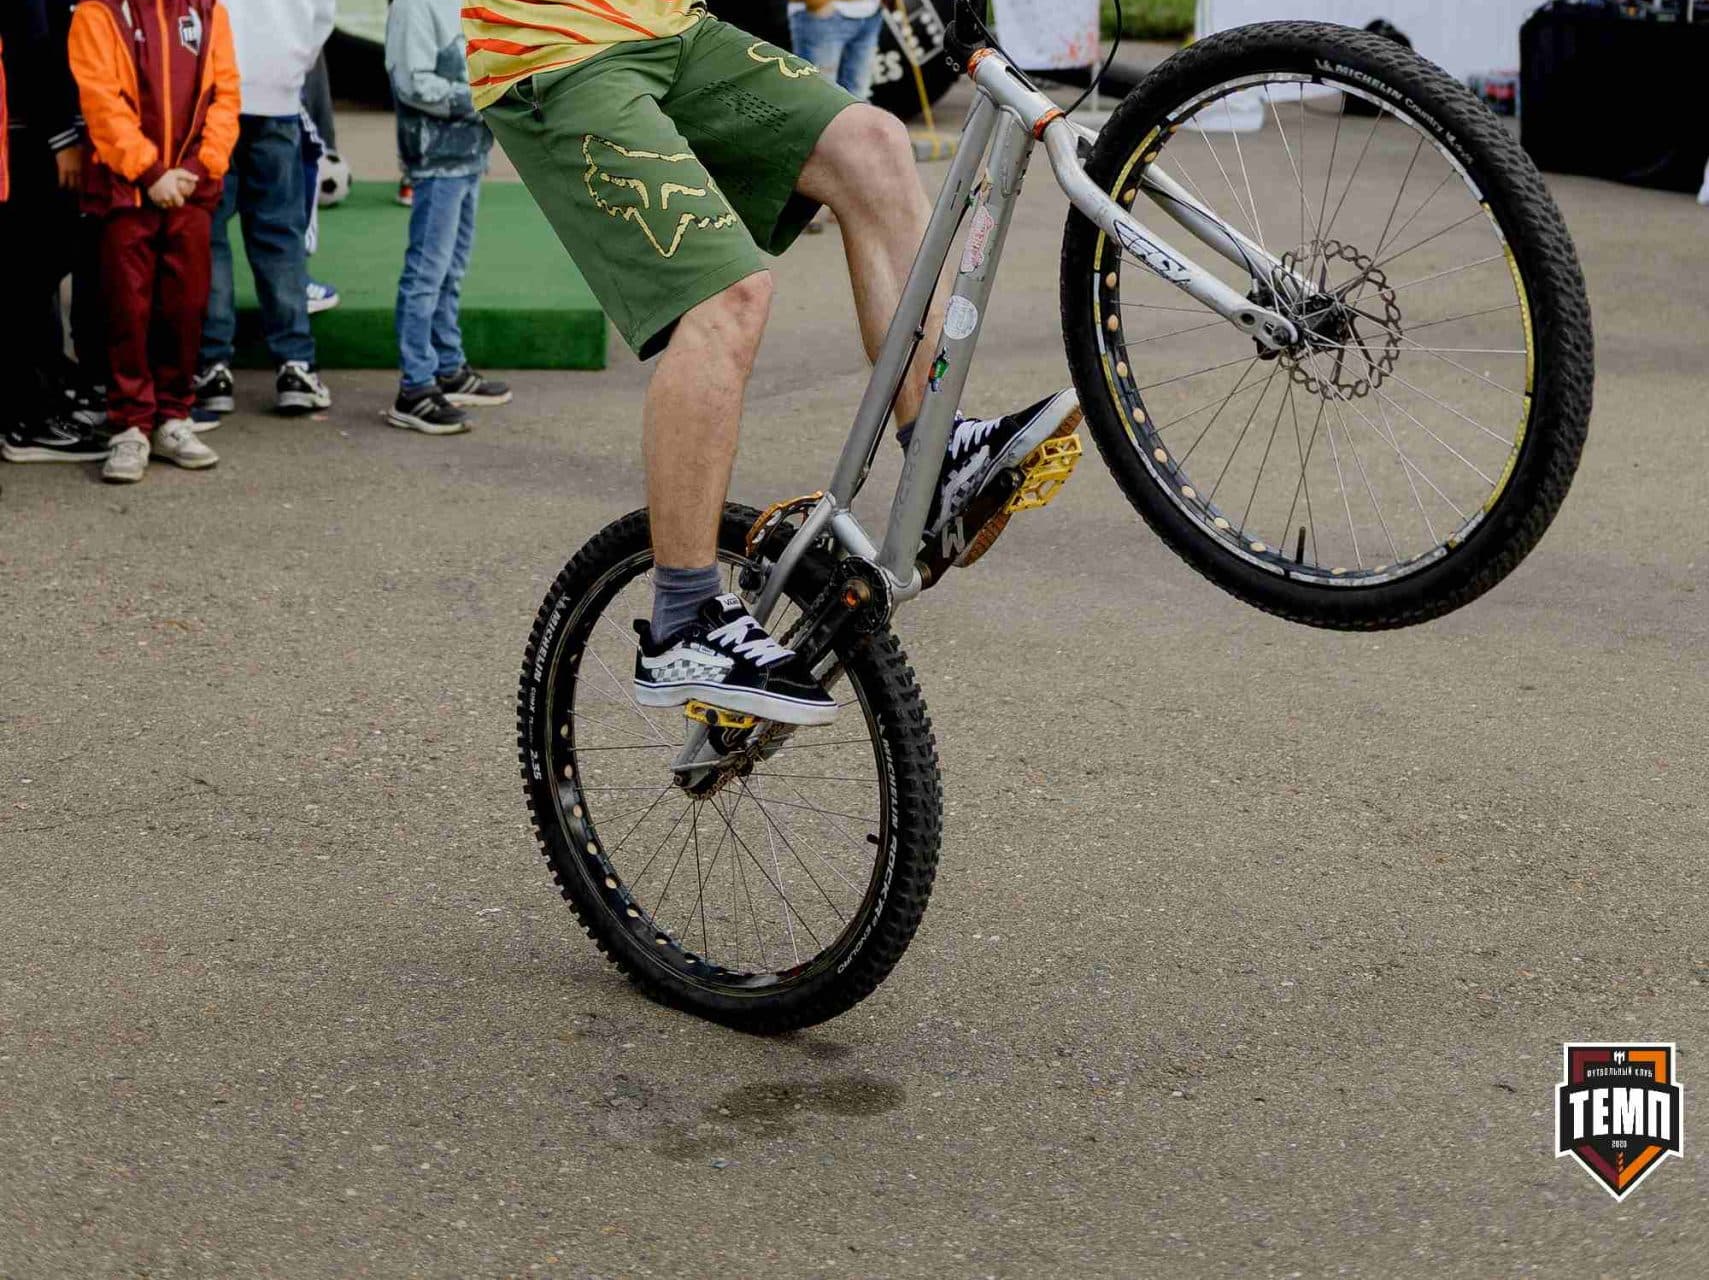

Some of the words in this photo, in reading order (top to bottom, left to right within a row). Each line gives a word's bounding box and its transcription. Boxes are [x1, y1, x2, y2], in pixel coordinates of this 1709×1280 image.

[1336, 64, 1402, 99] MICHELIN
[534, 613, 562, 682] MICHELIN
[882, 738, 899, 829] MICHELIN
